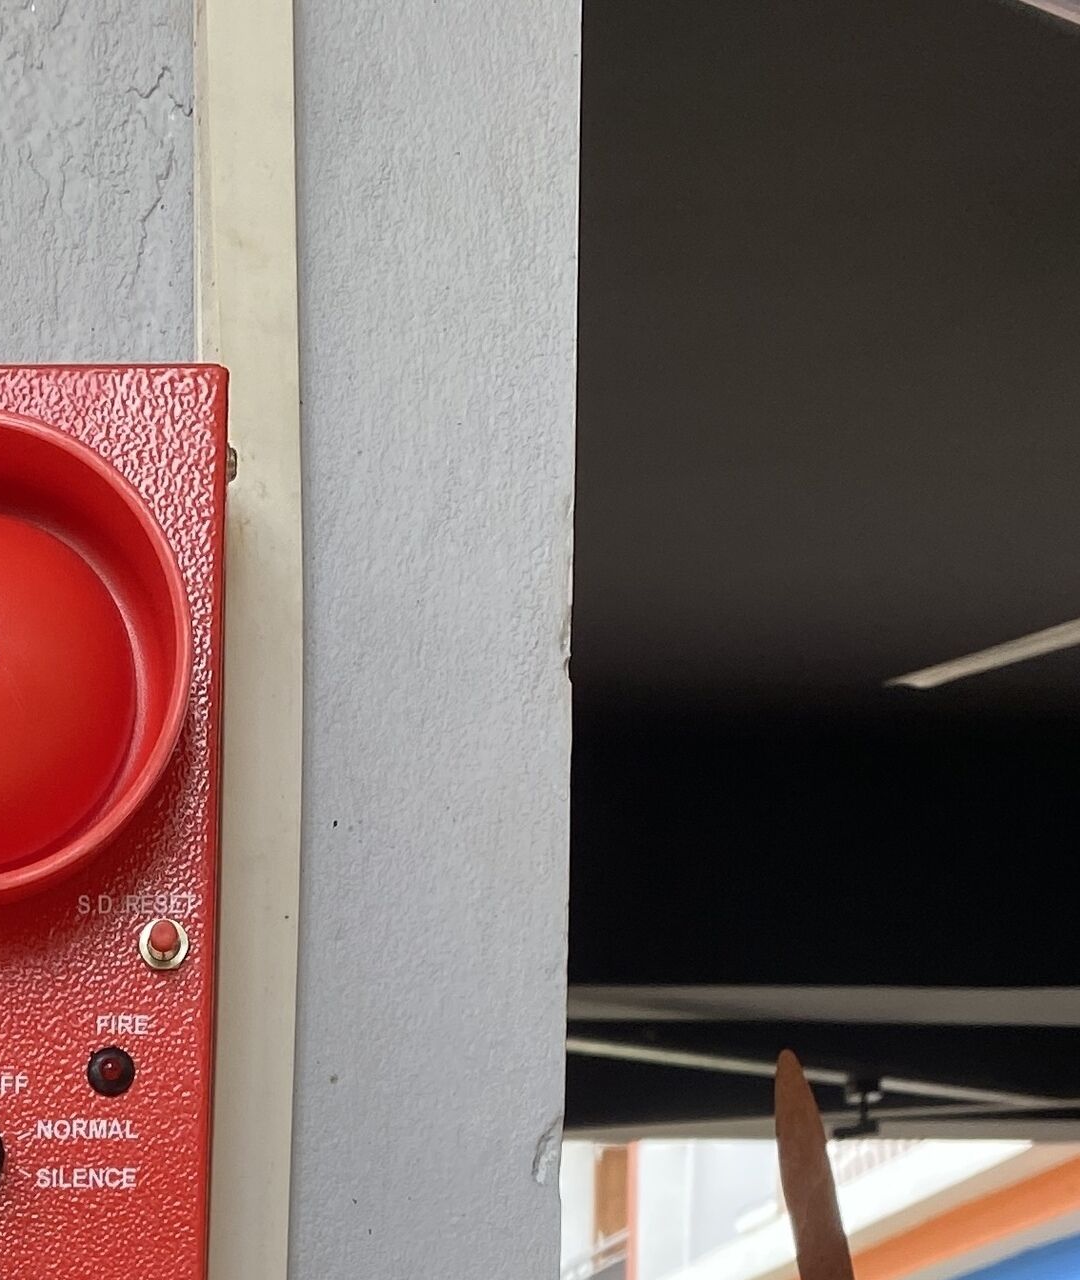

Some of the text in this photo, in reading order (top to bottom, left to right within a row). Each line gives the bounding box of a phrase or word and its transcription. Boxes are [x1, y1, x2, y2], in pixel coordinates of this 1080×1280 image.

[126, 894, 196, 915] RESET
[96, 1014, 149, 1035] FIRE
[36, 1119, 139, 1139] NORMAL
[36, 1166, 137, 1188] SILENCE
